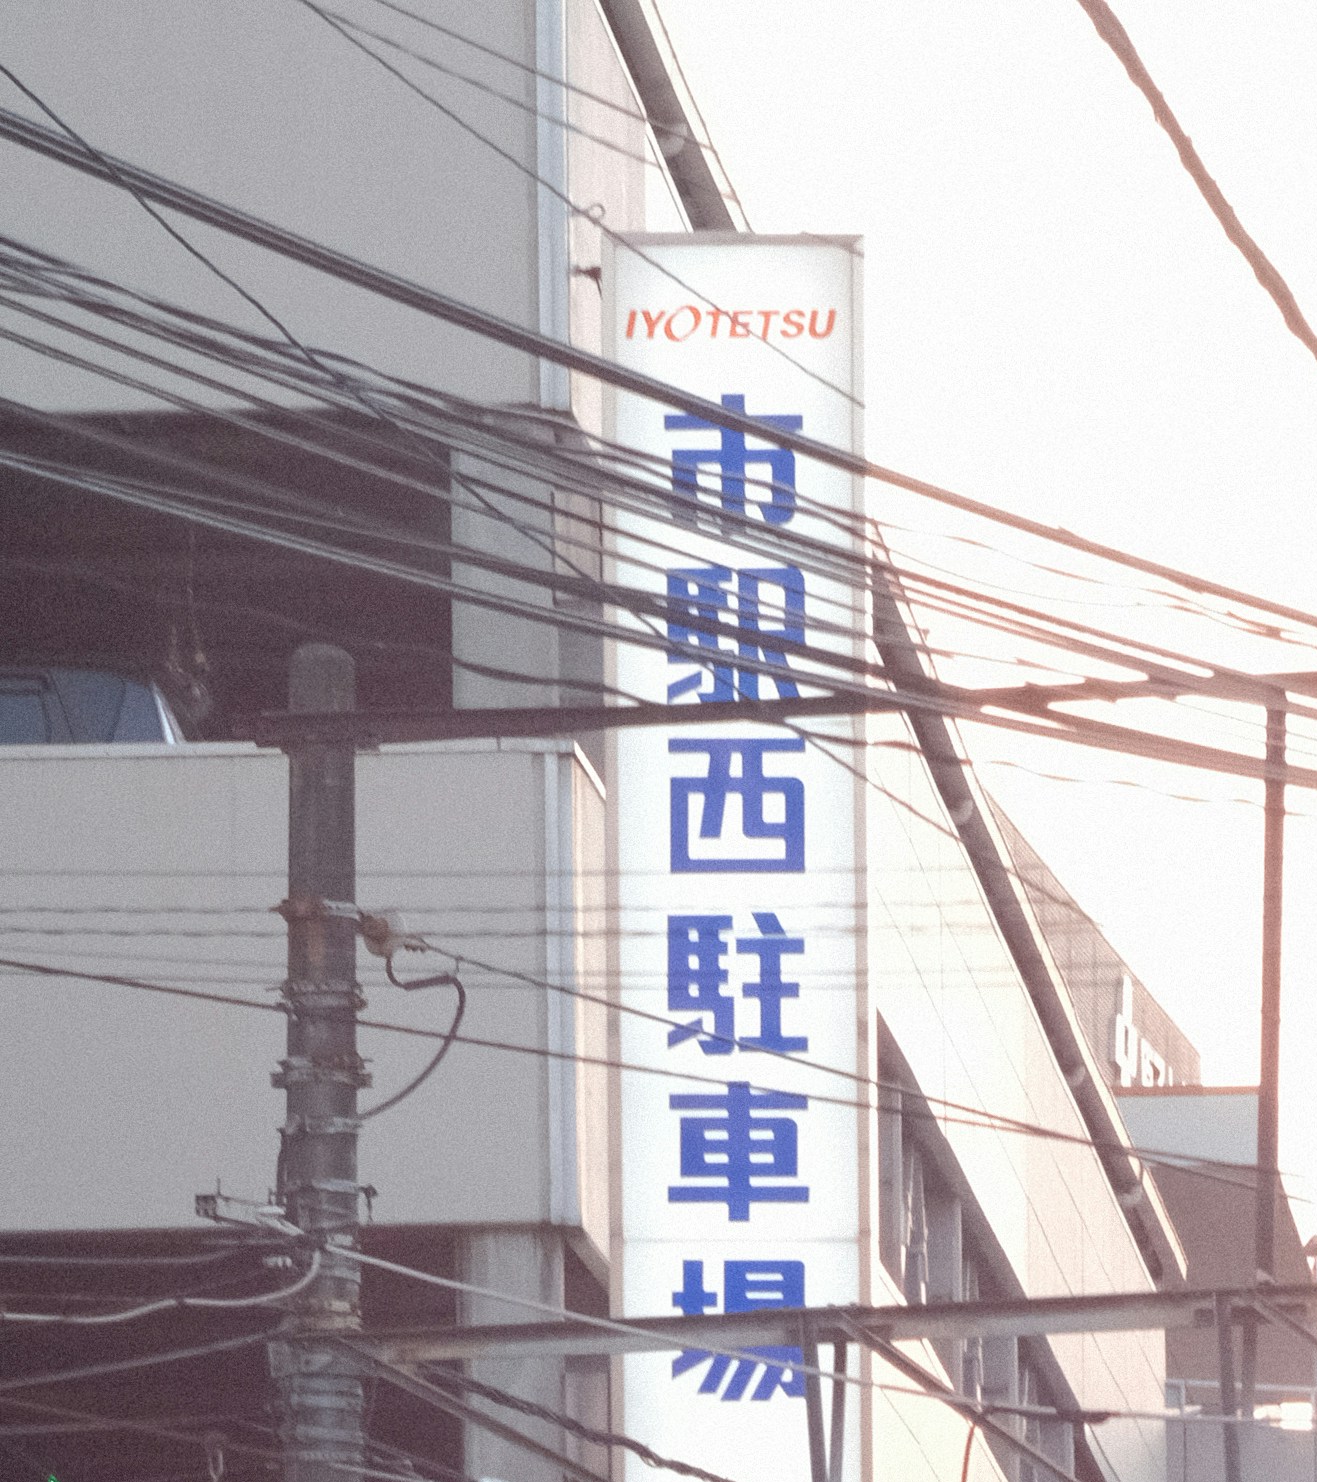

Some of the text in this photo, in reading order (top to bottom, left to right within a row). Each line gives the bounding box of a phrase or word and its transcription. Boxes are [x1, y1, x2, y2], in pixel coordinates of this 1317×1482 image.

[626, 304, 836, 342] IYOTETSU
[664, 394, 809, 1402] 市駅西駐車場
